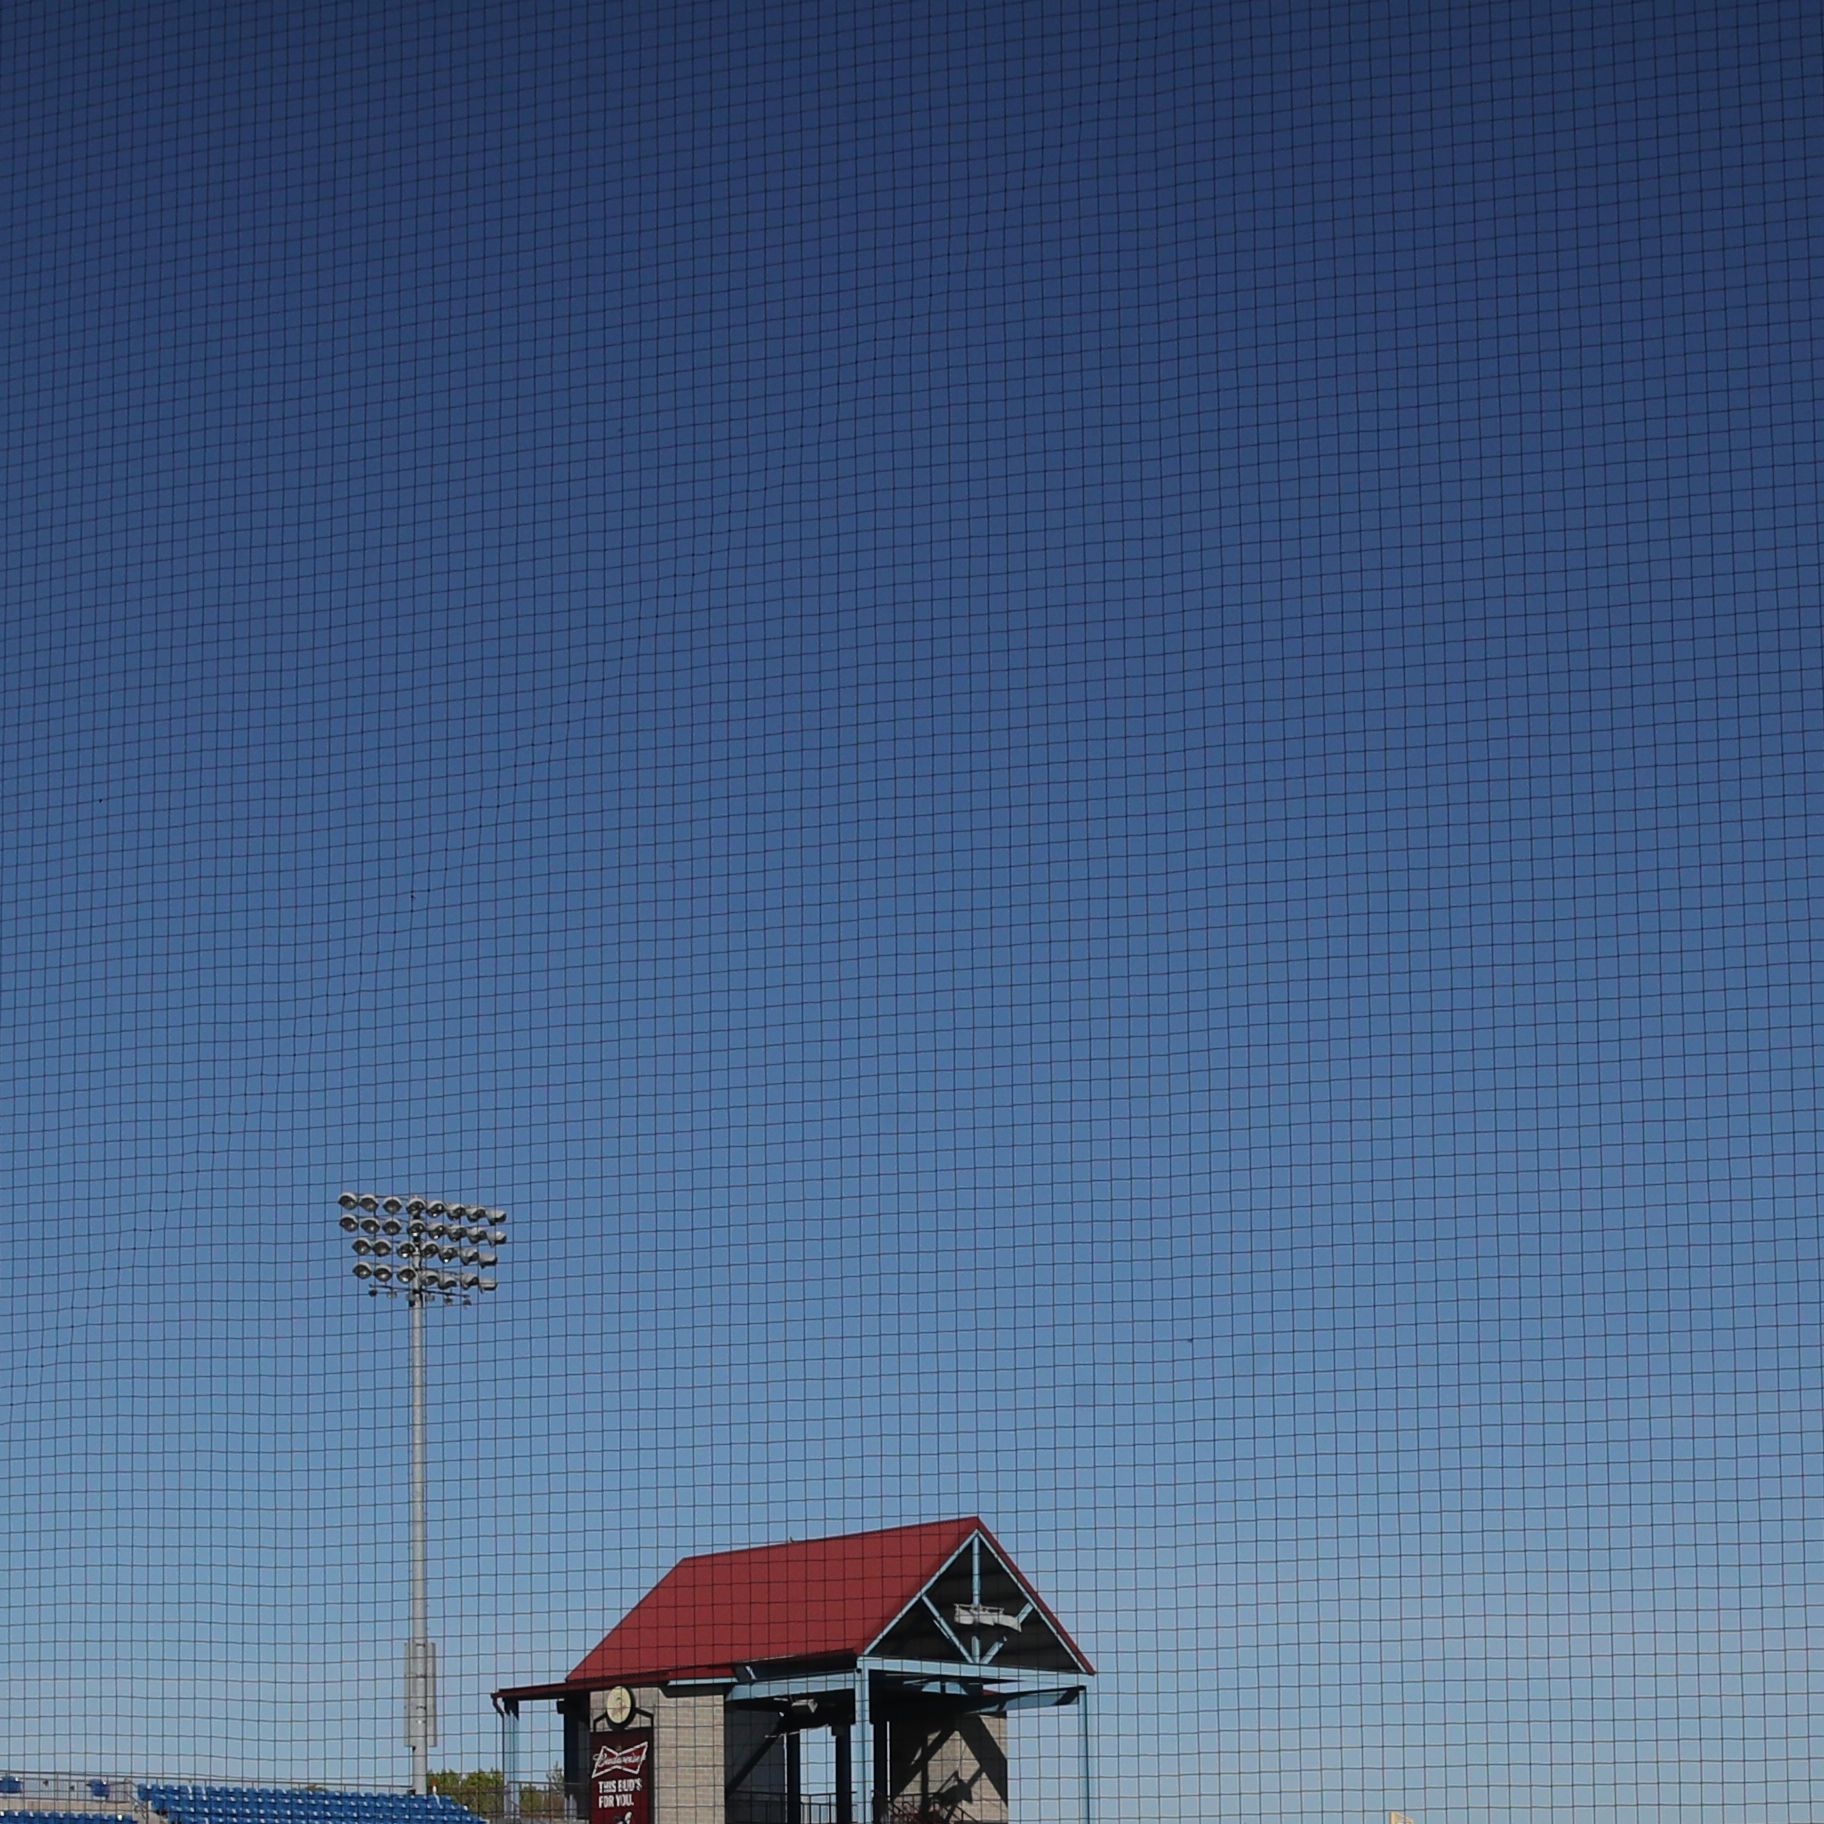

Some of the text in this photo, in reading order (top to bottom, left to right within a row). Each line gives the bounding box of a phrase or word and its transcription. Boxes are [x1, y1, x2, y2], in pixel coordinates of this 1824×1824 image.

[598, 1777, 643, 1794] THIS BUD'S
[598, 1793, 635, 1809] FOR YOU.
